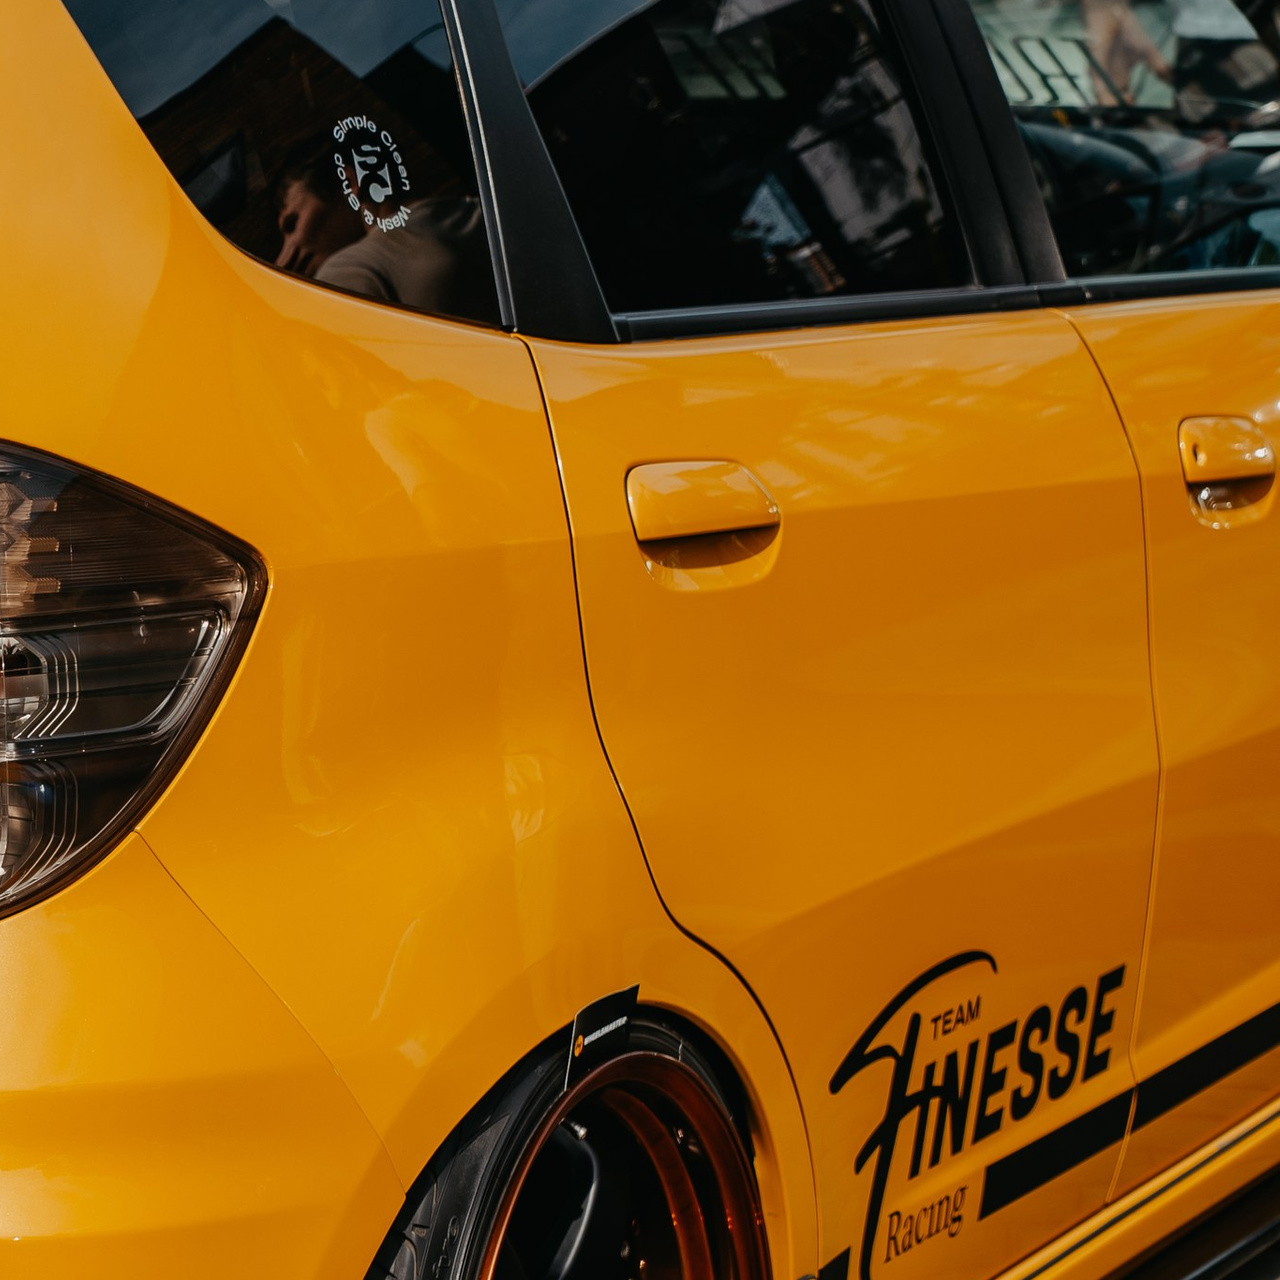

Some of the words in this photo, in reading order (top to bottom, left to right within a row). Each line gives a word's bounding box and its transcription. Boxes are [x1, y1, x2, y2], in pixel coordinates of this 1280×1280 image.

[333, 115, 376, 142] Simple
[334, 153, 361, 211] Shop
[381, 131, 410, 191] Clean
[377, 205, 411, 232] Wash
[930, 995, 982, 1042] TEAM
[883, 1184, 969, 1264] Racing
